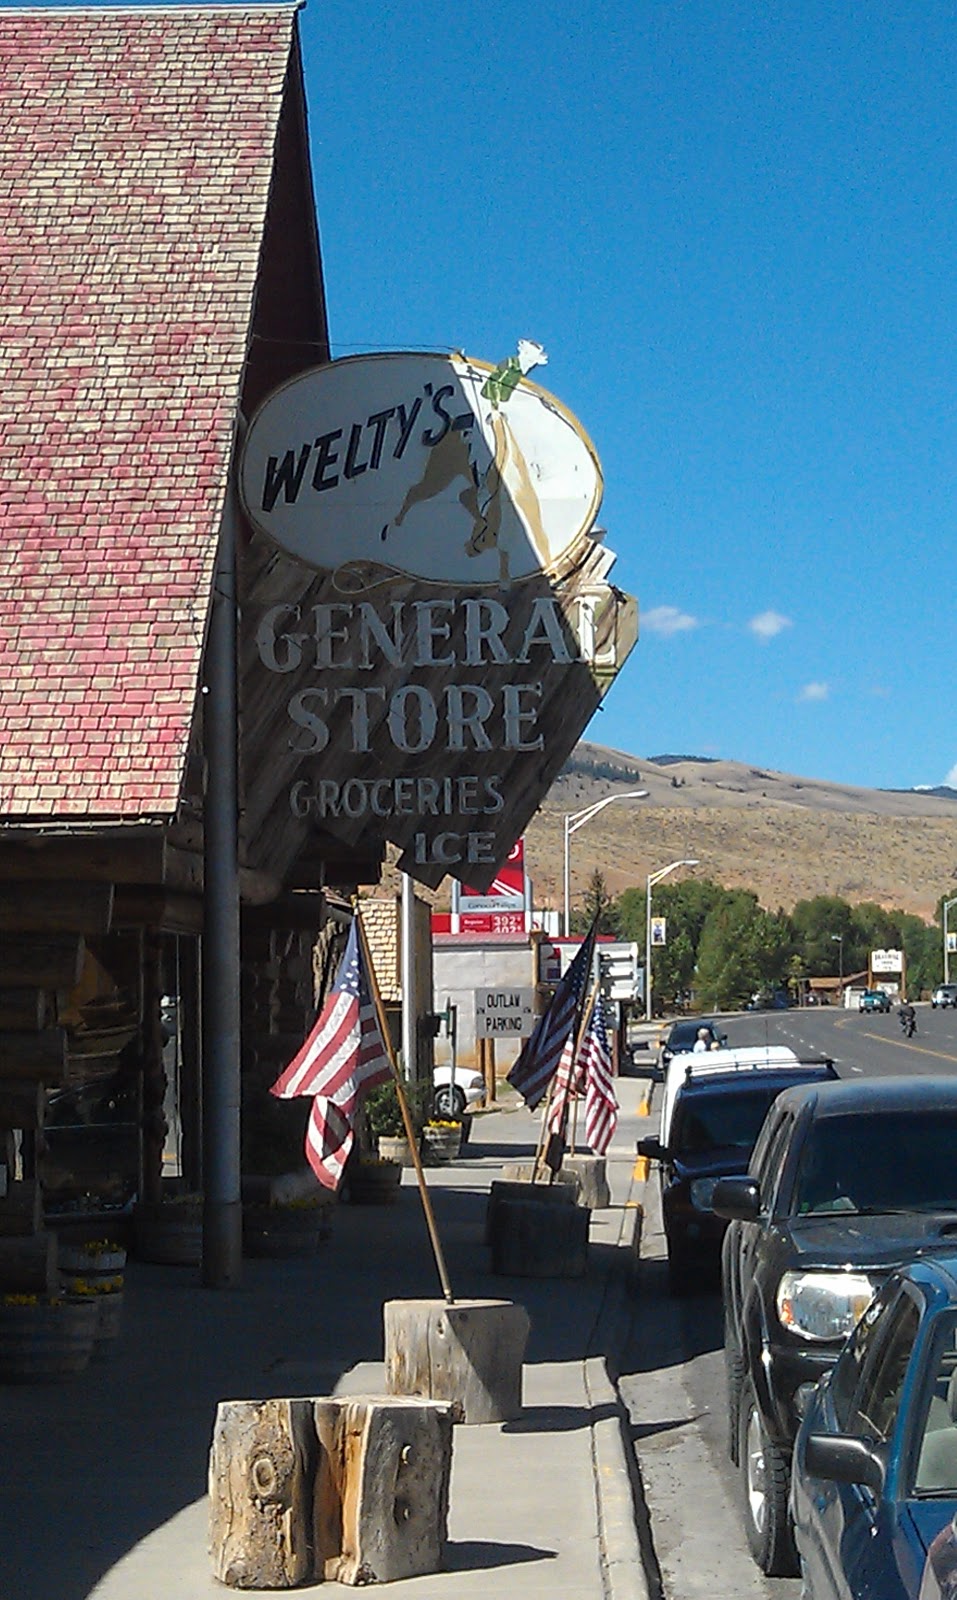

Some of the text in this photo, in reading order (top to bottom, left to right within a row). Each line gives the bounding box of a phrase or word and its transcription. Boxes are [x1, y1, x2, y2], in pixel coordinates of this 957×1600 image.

[261, 382, 455, 512] WELTY'S
[256, 596, 619, 674] GENERAL
[287, 682, 545, 756] STORE
[289, 774, 506, 819] GROCERIES
[413, 831, 497, 865] ICE
[486, 993, 521, 1008] OUTLAW
[485, 1016, 522, 1032] PARKING
